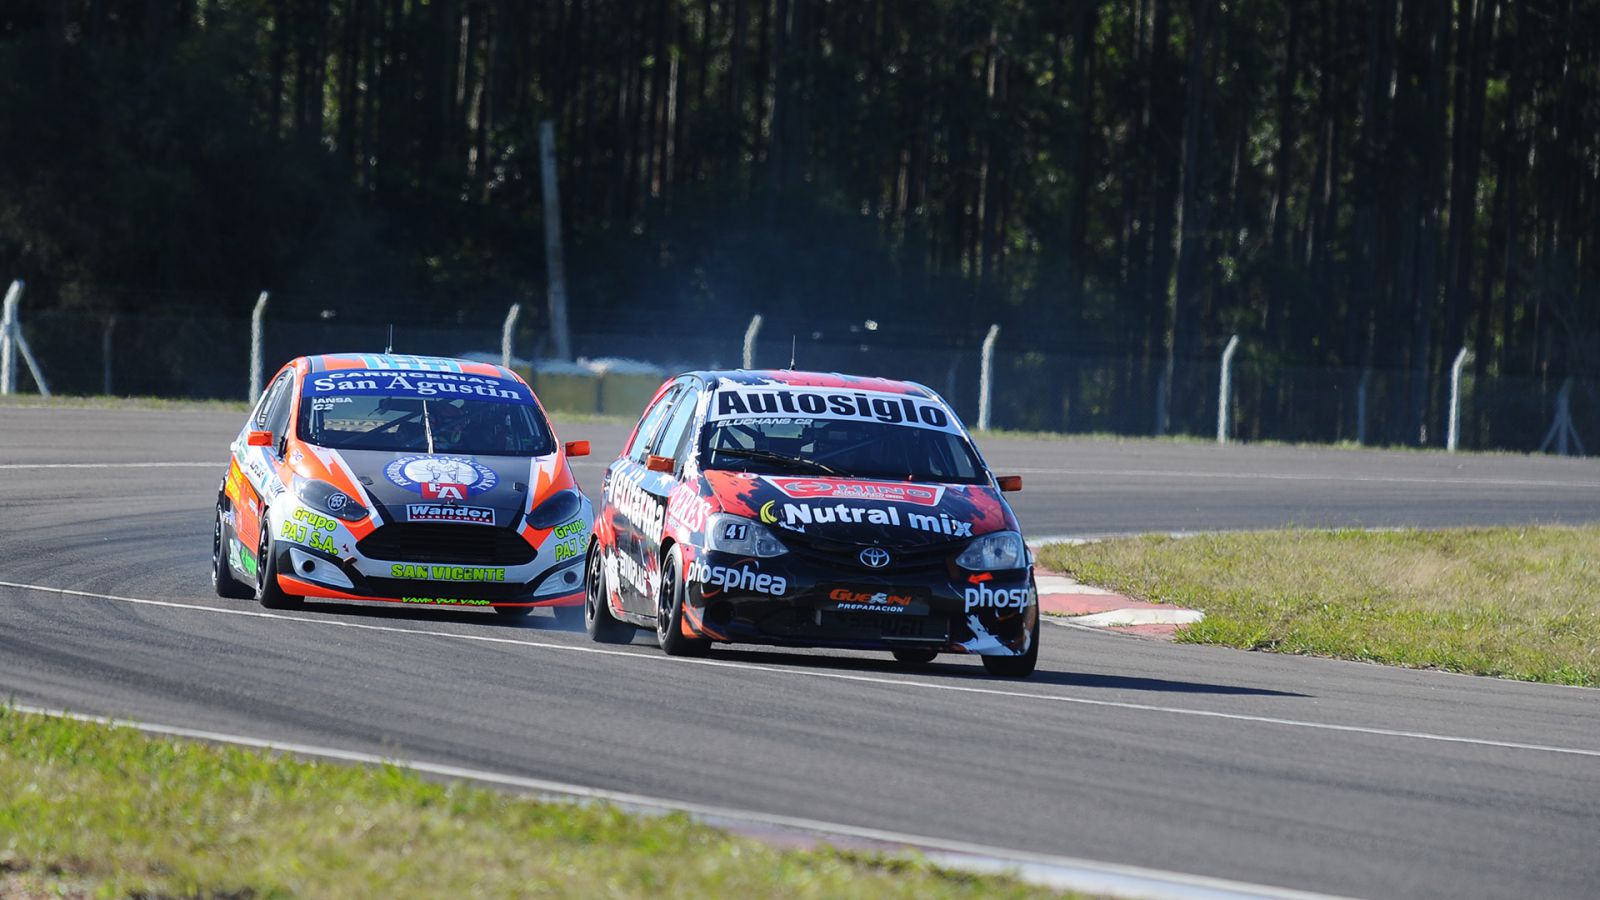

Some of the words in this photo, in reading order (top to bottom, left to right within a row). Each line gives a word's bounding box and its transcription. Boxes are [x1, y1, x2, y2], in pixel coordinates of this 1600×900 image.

[314, 378, 378, 393] San
[386, 376, 520, 400] Agustin
[329, 371, 500, 386] CARNICERIAS
[313, 403, 335, 411] C2
[718, 390, 948, 427] Autosiglo
[717, 418, 791, 427] ELUCHANS
[293, 507, 337, 531] Grupo
[411, 505, 491, 519] Wander
[784, 503, 900, 526] Nutral
[908, 511, 973, 537] mix
[281, 520, 307, 543] PAJ
[309, 532, 339, 555] S.A.
[553, 519, 586, 540] Grupo
[725, 524, 746, 539] 41
[555, 537, 577, 562] PAJ
[391, 563, 428, 579] SAN
[431, 565, 505, 581] VICENTE
[687, 561, 787, 596] phosphea
[837, 603, 904, 613] PREPARACION
[965, 582, 1036, 613] phosp
